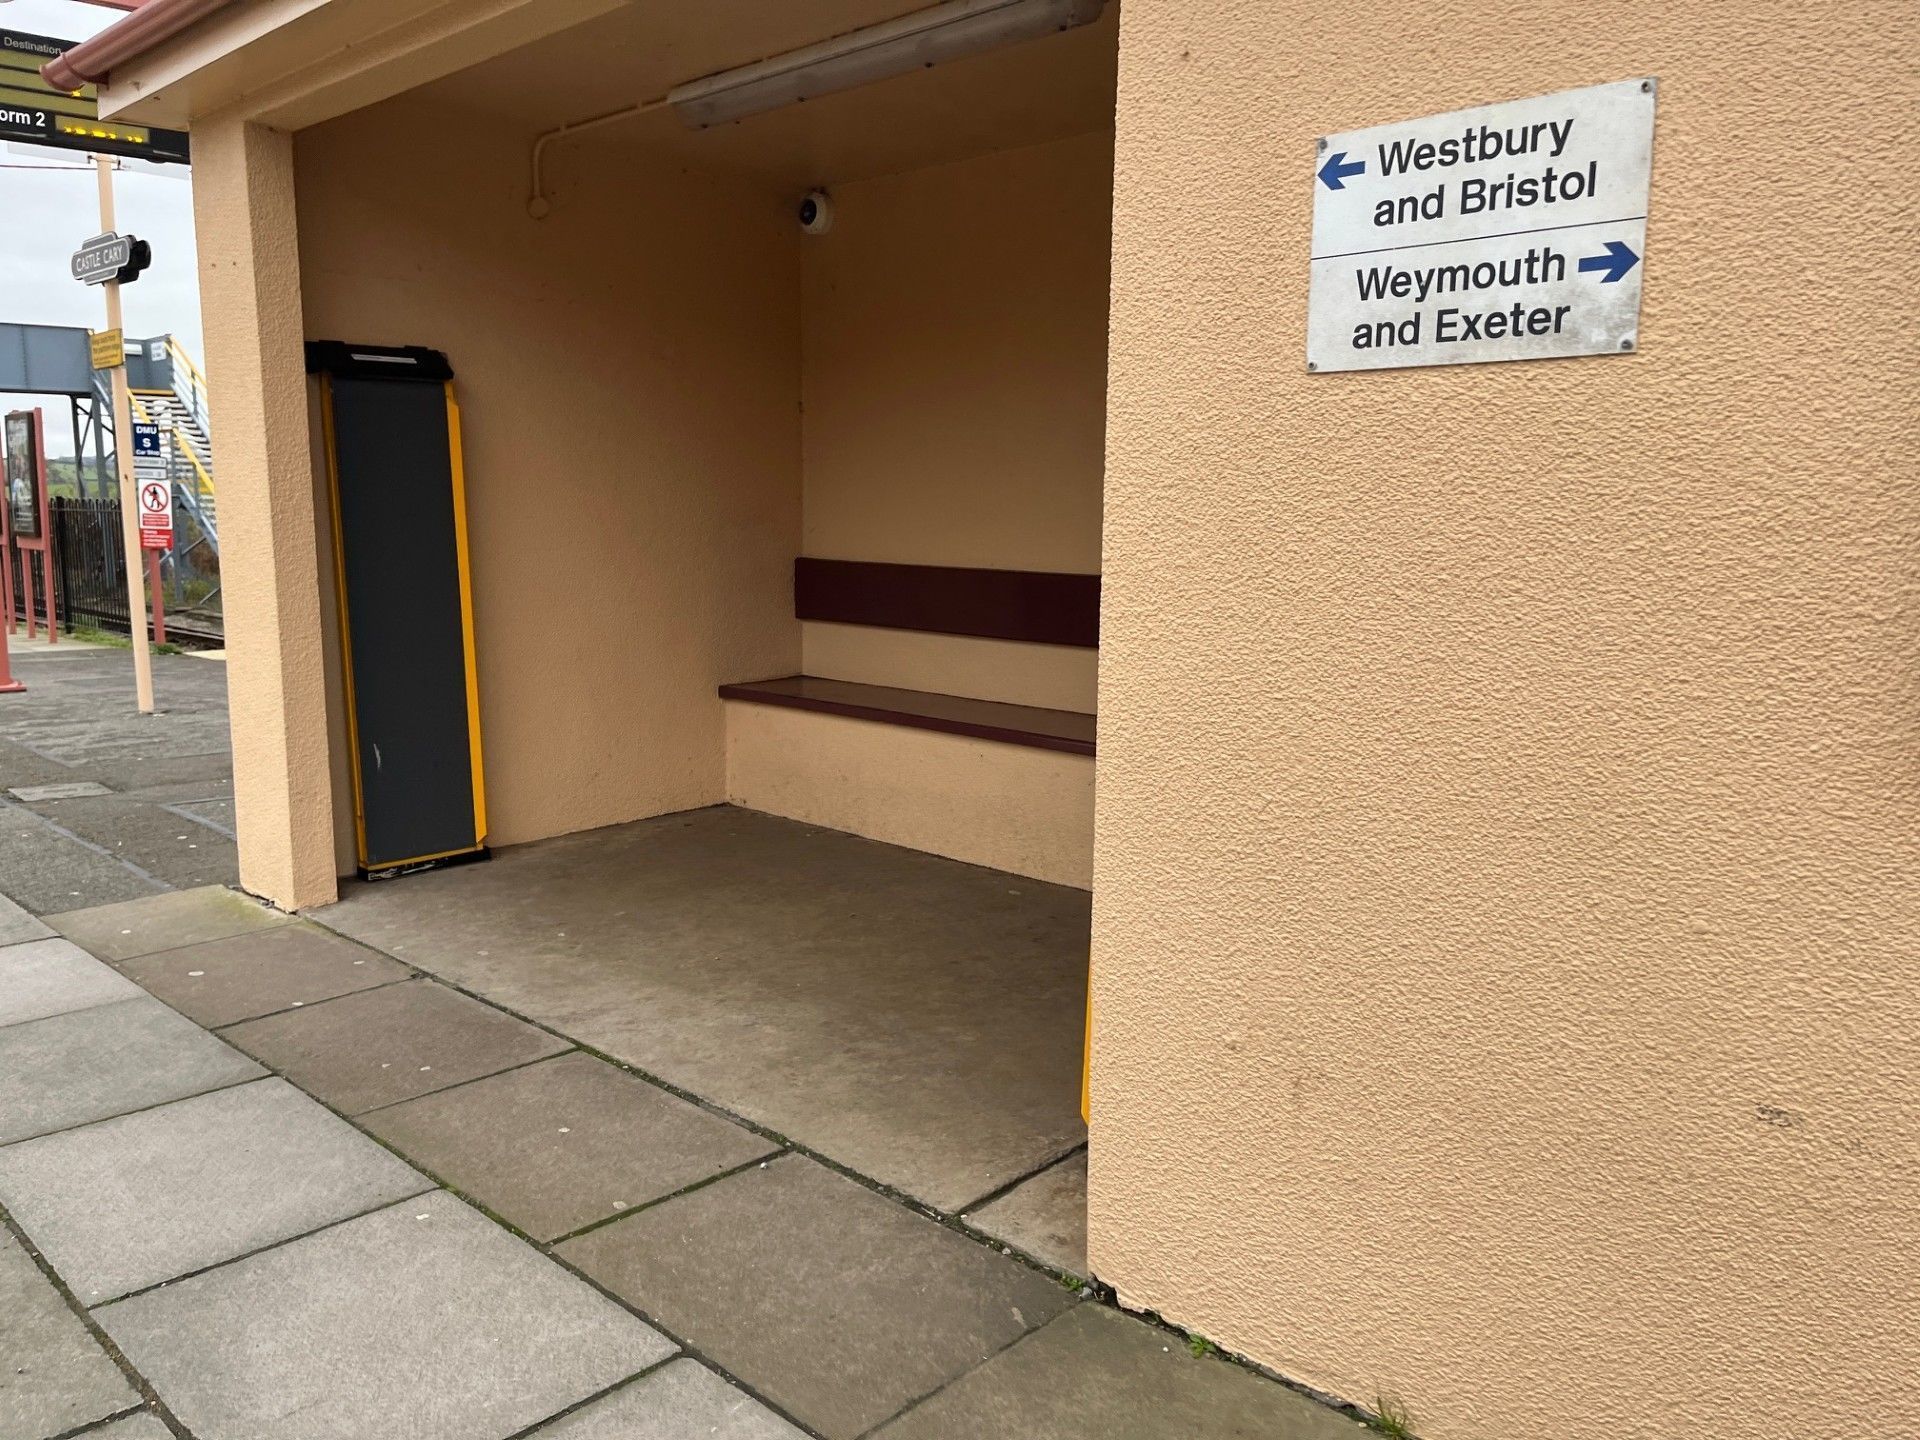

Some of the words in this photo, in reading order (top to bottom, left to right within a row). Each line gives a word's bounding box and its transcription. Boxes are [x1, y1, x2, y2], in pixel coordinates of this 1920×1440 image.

[4, 36, 62, 55] Destination
[35, 112, 46, 127] 2
[1378, 118, 1575, 177] Westbury
[1373, 184, 1445, 227] and
[1460, 160, 1598, 215] Bristol
[76, 253, 100, 271] CASTLE
[103, 245, 122, 263] CARY
[1356, 247, 1566, 303] Weymouth
[1352, 312, 1421, 350] and
[1435, 302, 1571, 343] Exeter
[136, 426, 157, 434] DMU
[142, 437, 151, 447] S
